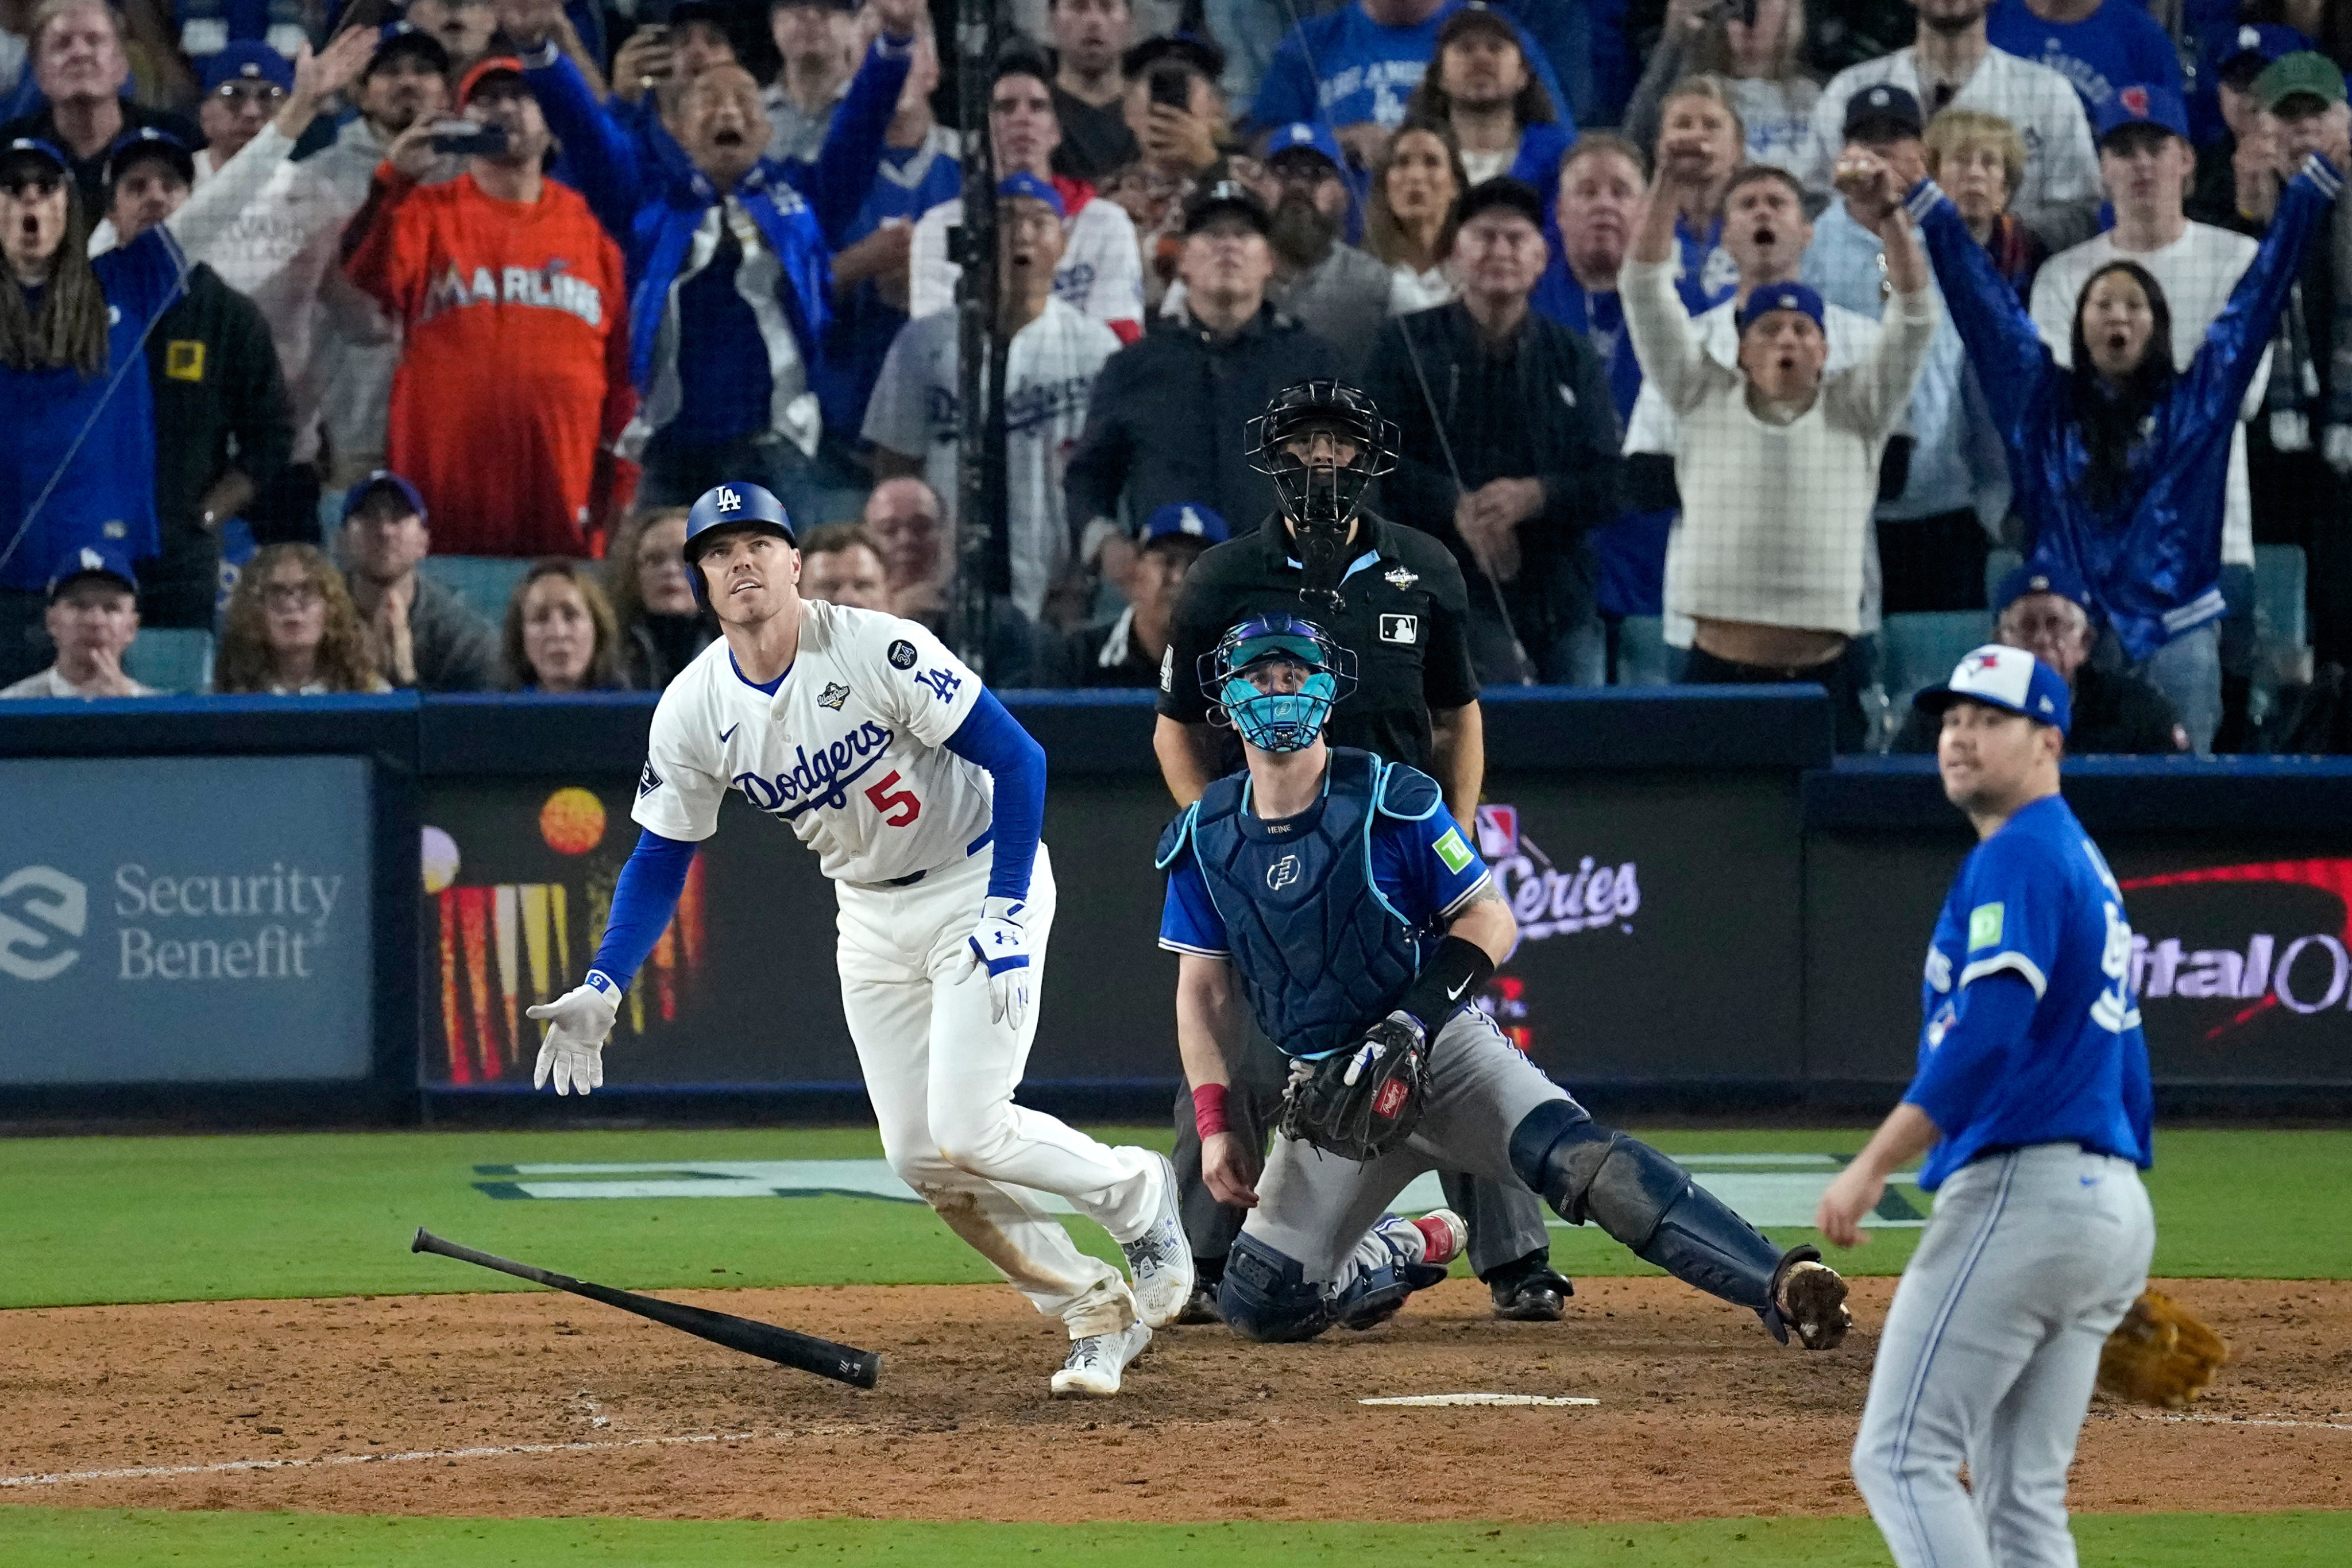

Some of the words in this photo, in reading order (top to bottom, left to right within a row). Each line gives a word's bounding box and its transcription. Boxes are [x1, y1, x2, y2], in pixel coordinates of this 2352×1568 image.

[716, 486, 741, 512] LA
[897, 646, 914, 665] 34
[914, 668, 961, 704] LA
[733, 720, 894, 821] Dodgers
[864, 769, 921, 827] 5
[1267, 824, 1291, 834] HEINE
[1441, 836, 1466, 860] TD
[115, 862, 343, 928] Security
[118, 925, 315, 978] Benefit
[590, 975, 603, 986] 5
[1382, 1084, 1400, 1114] Rawlings
